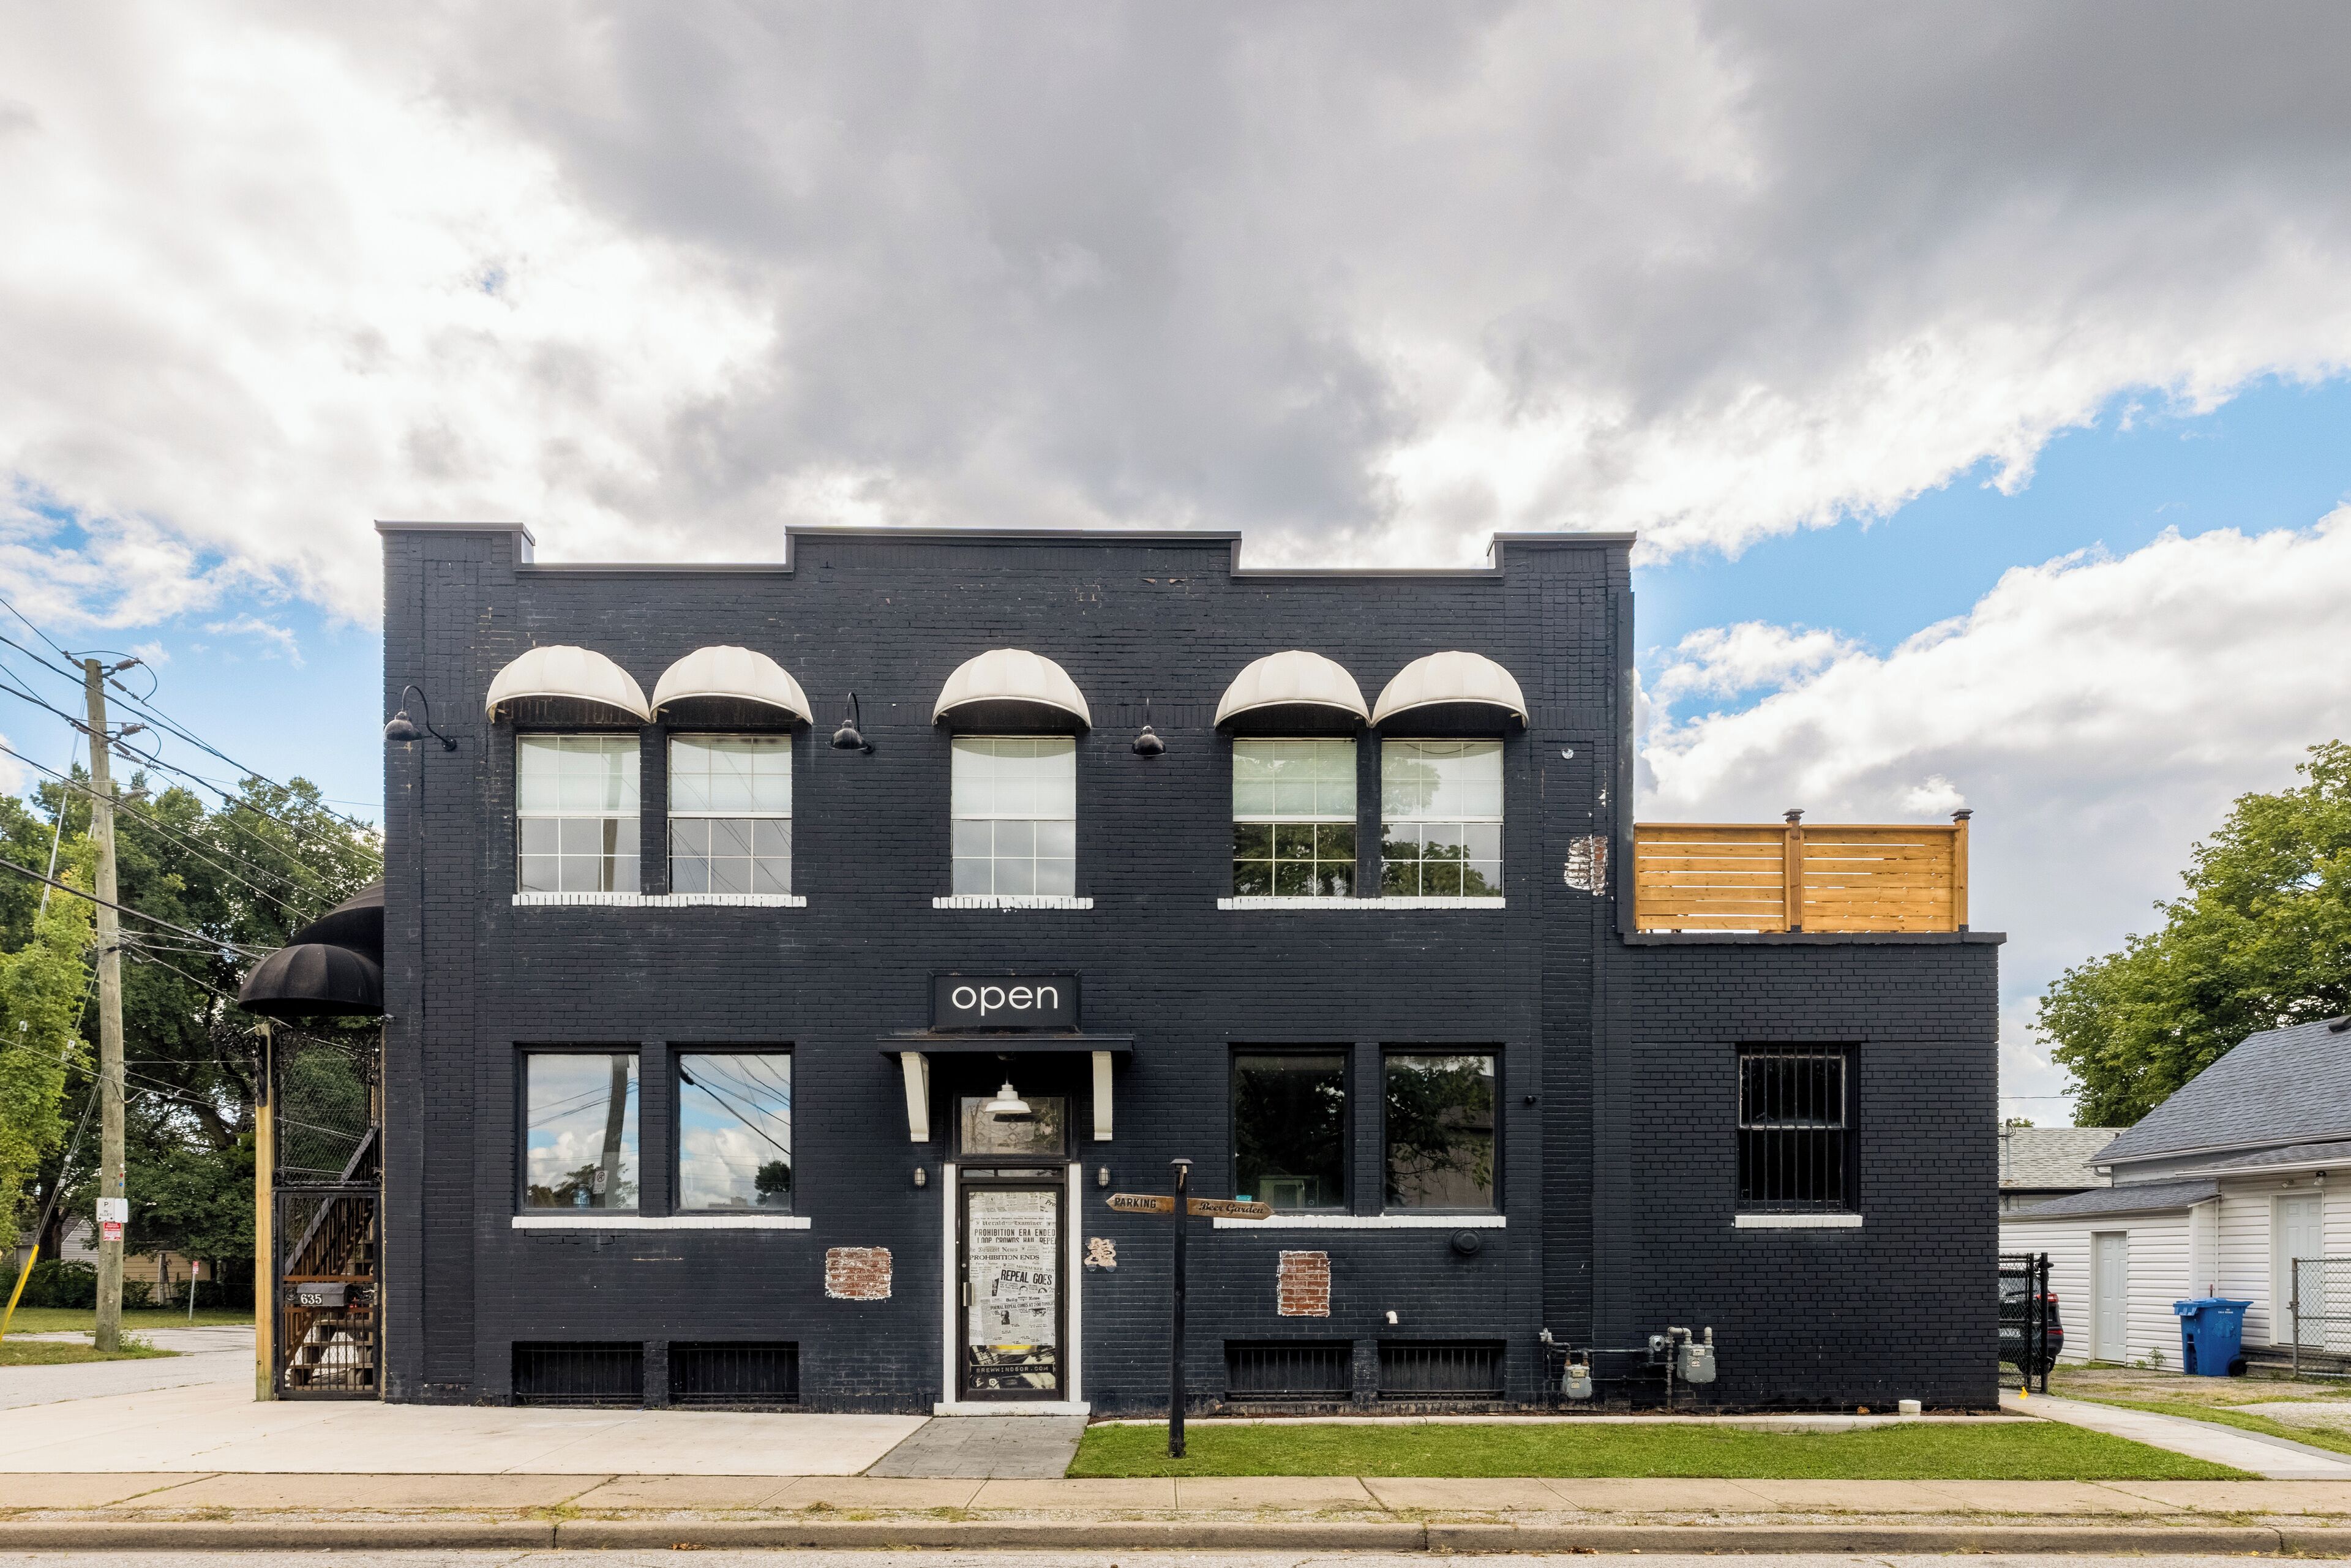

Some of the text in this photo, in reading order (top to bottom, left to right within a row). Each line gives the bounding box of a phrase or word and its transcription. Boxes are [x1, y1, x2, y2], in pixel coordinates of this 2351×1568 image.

[951, 986, 1059, 1016] open
[1114, 1197, 1157, 1209] PARKING
[1199, 1201, 1265, 1214] Beer Garden
[1000, 1269, 1029, 1283] REPEAL
[1033, 1273, 1052, 1286] GOES
[301, 1293, 322, 1305] 635
